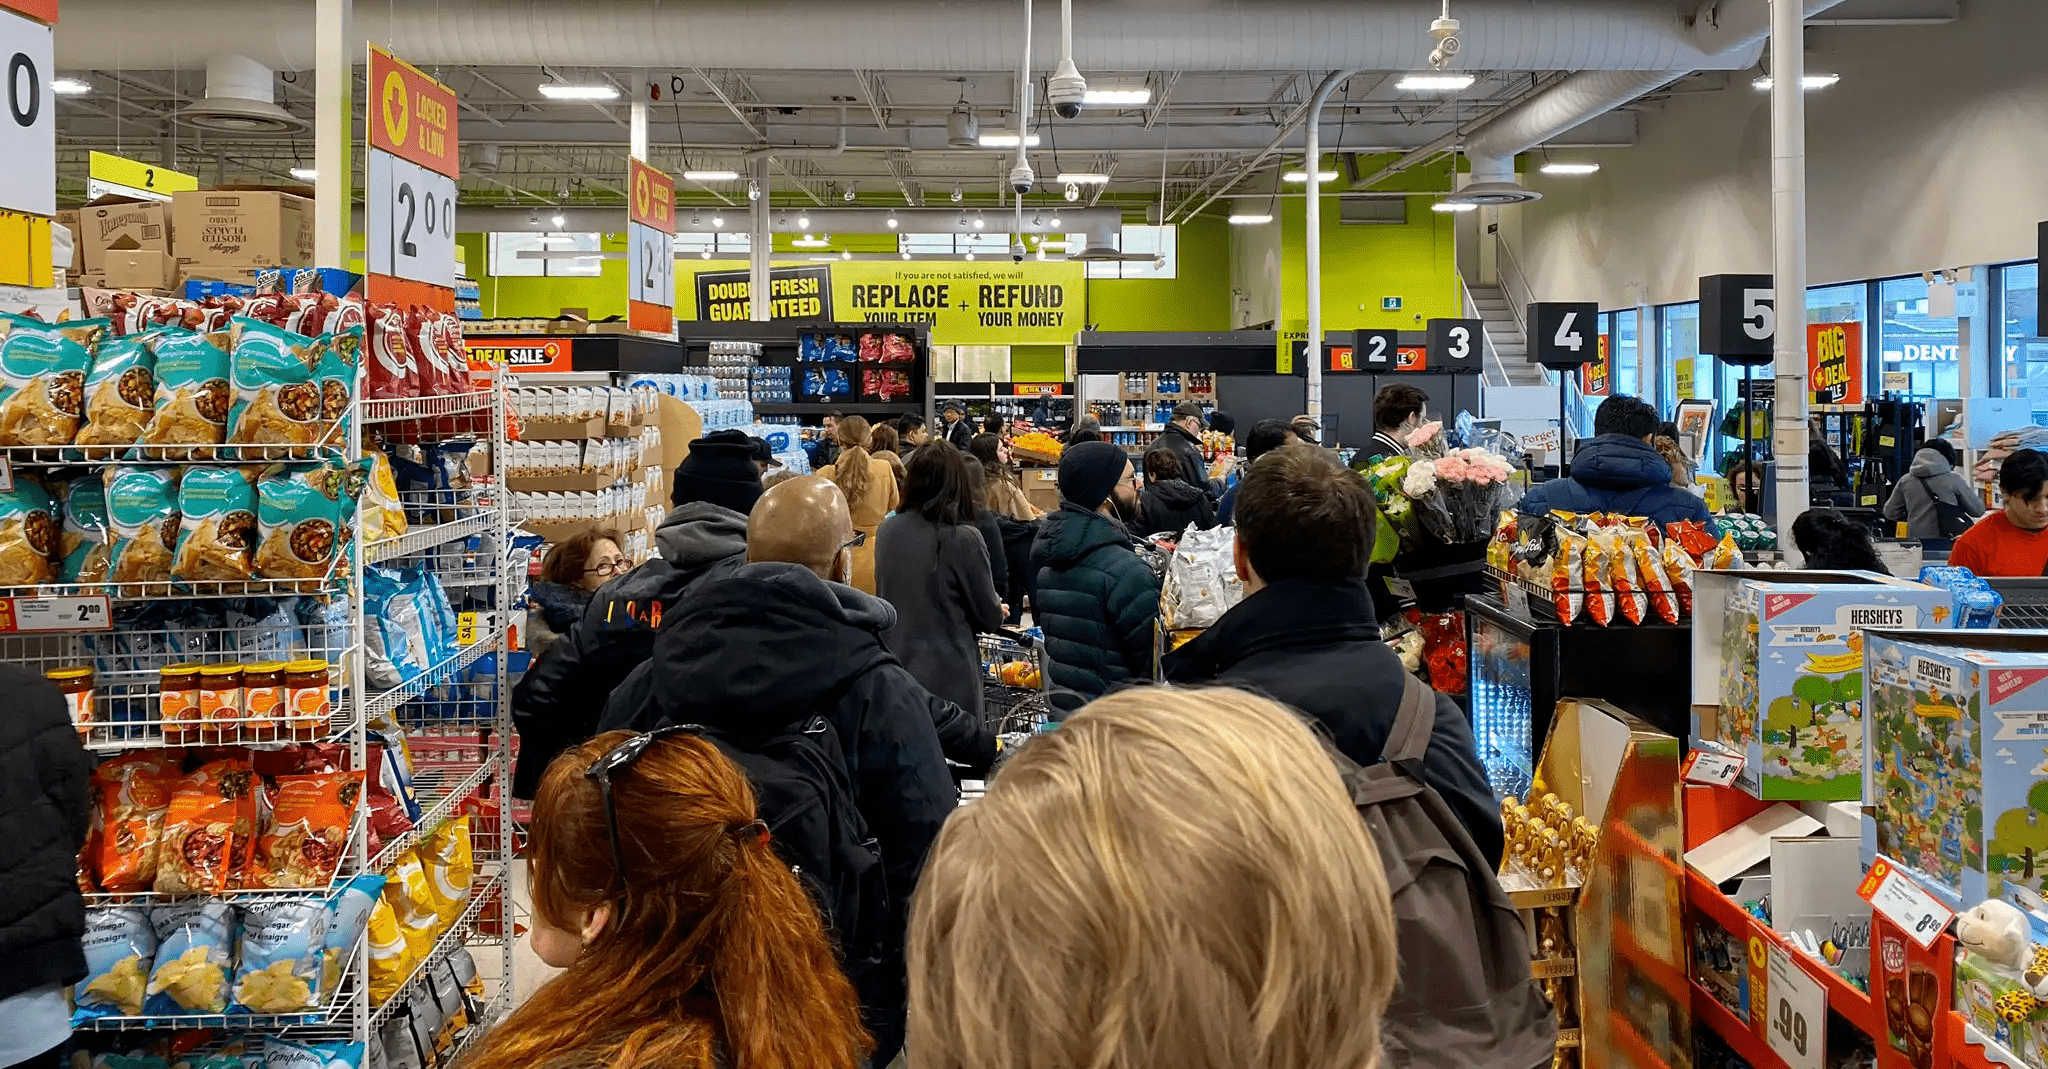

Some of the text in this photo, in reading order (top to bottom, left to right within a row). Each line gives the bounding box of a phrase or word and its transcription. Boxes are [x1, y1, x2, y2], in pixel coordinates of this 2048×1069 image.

[416, 91, 446, 130] LOCKED
[427, 128, 444, 158] LOW
[145, 169, 154, 187] 2
[100, 211, 149, 240] Honeycomb
[202, 234, 247, 243] FROSTED
[771, 278, 819, 296] FRESH
[953, 271, 991, 281] satisfied,
[1008, 271, 1023, 279] will
[852, 285, 949, 308] REPLACE
[979, 285, 1063, 308] REFUND
[904, 312, 937, 326] ITEM
[978, 312, 1064, 326] YOUR MONEY
[1743, 289, 1774, 340] 5
[1554, 312, 1582, 351] 4
[1368, 336, 1387, 362] 2
[1448, 327, 1470, 359] 3
[1818, 326, 1844, 363] BIG
[510, 349, 544, 364] SALE
[1825, 363, 1851, 387] DEAL
[1521, 429, 1556, 445] Forget
[1851, 609, 1903, 624] HERSHEY'S
[462, 617, 472, 639] SALE
[1917, 659, 1951, 682] HERSHEY'S
[92, 921, 126, 934] Vinegar
[92, 933, 127, 945] vinaigre
[1773, 997, 1808, 1057] .99
